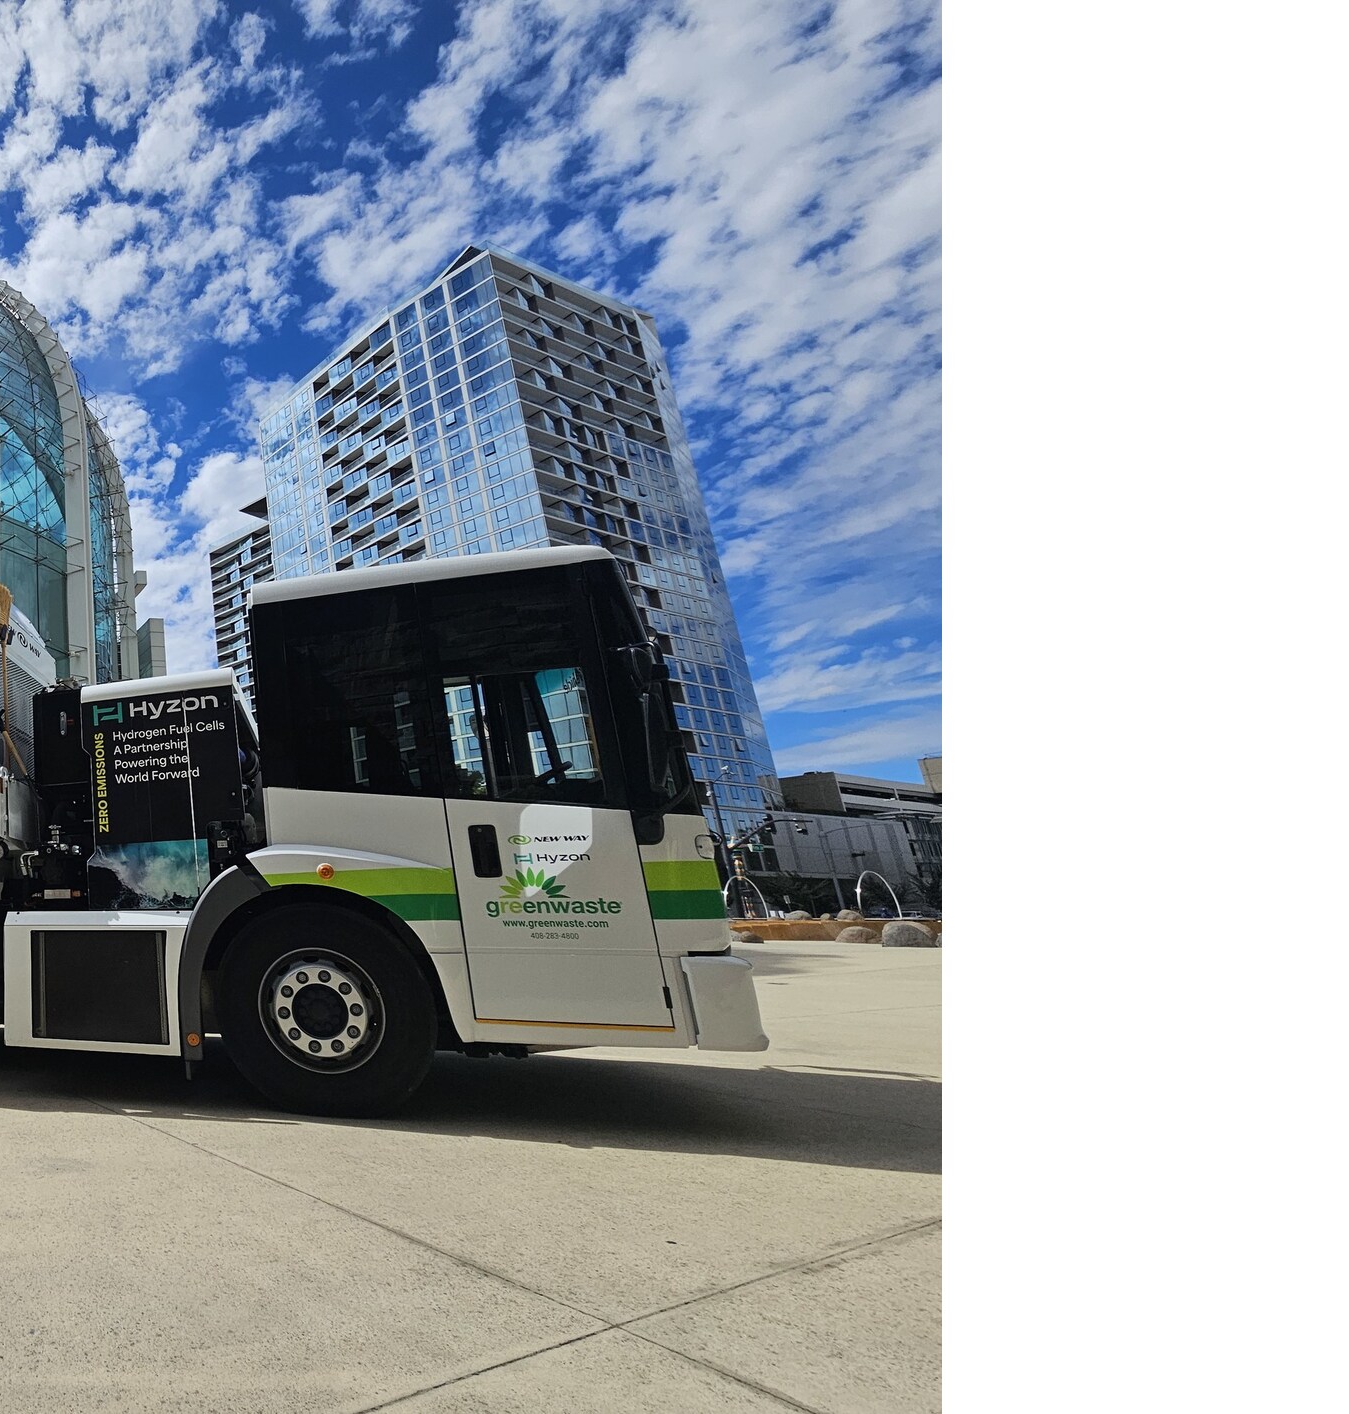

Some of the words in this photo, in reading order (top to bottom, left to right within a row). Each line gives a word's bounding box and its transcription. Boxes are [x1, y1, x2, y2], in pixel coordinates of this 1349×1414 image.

[129, 695, 219, 720] Hyzon
[112, 727, 167, 743] Hydrogen
[169, 723, 193, 735] Fuel
[195, 720, 225, 732] Cells
[113, 745, 122, 756] A
[124, 739, 188, 754] Partnership
[94, 732, 107, 798] EMISSIONS
[114, 755, 167, 770] Powering
[169, 754, 189, 764] the
[115, 771, 149, 784] World
[151, 766, 200, 781] Forward
[98, 799, 109, 833] ZERO
[534, 835, 562, 843] NEW
[564, 834, 590, 842] WAY
[536, 853, 591, 864] Hyzon
[486, 897, 622, 918] greenwaste
[502, 919, 609, 929] www.greenwaste.com
[530, 932, 580, 940] 408-283-4800
